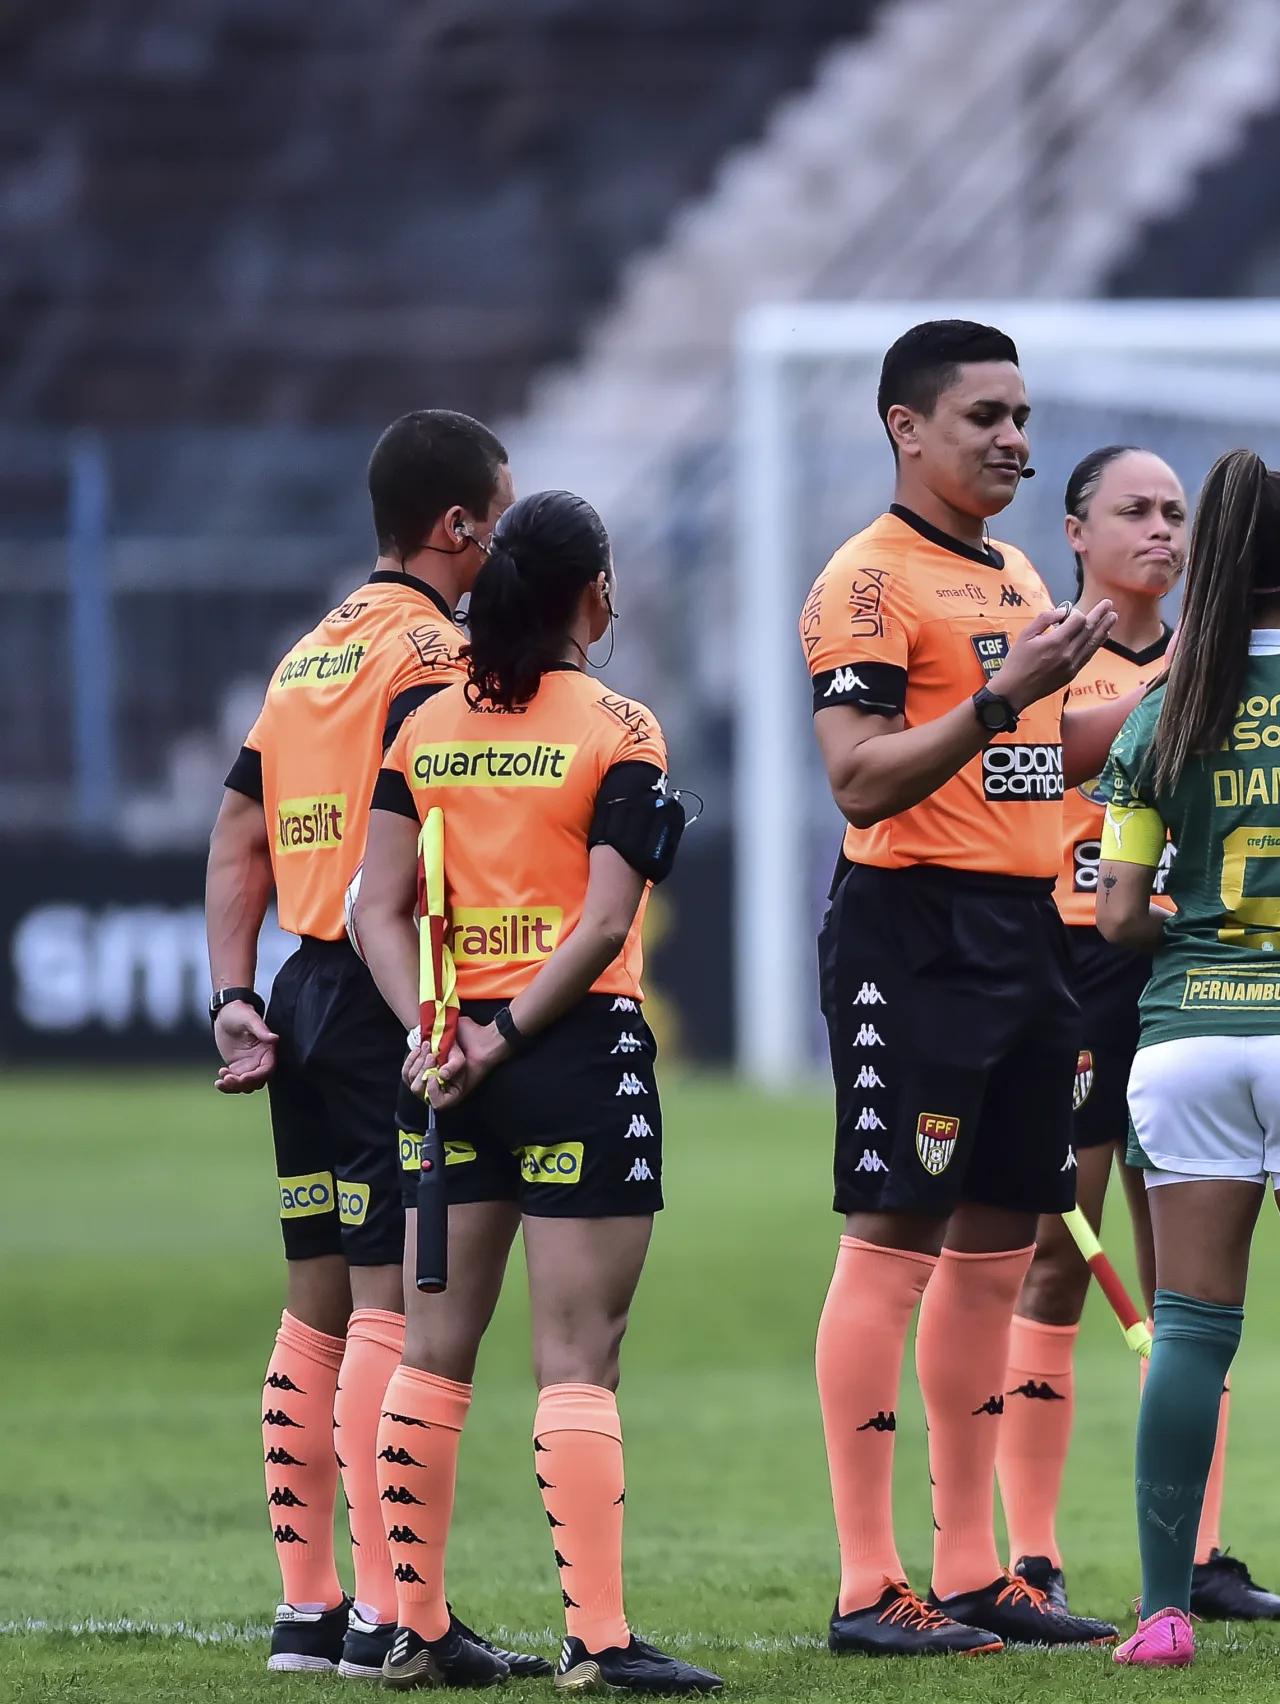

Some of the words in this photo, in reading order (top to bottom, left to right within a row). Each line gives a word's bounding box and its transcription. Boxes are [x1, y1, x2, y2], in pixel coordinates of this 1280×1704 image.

[279, 643, 366, 687] quartzolit
[978, 638, 1003, 656] CBF
[413, 744, 566, 782] quartzolit
[452, 915, 553, 955] rasilit
[924, 1119, 954, 1135] FPF
